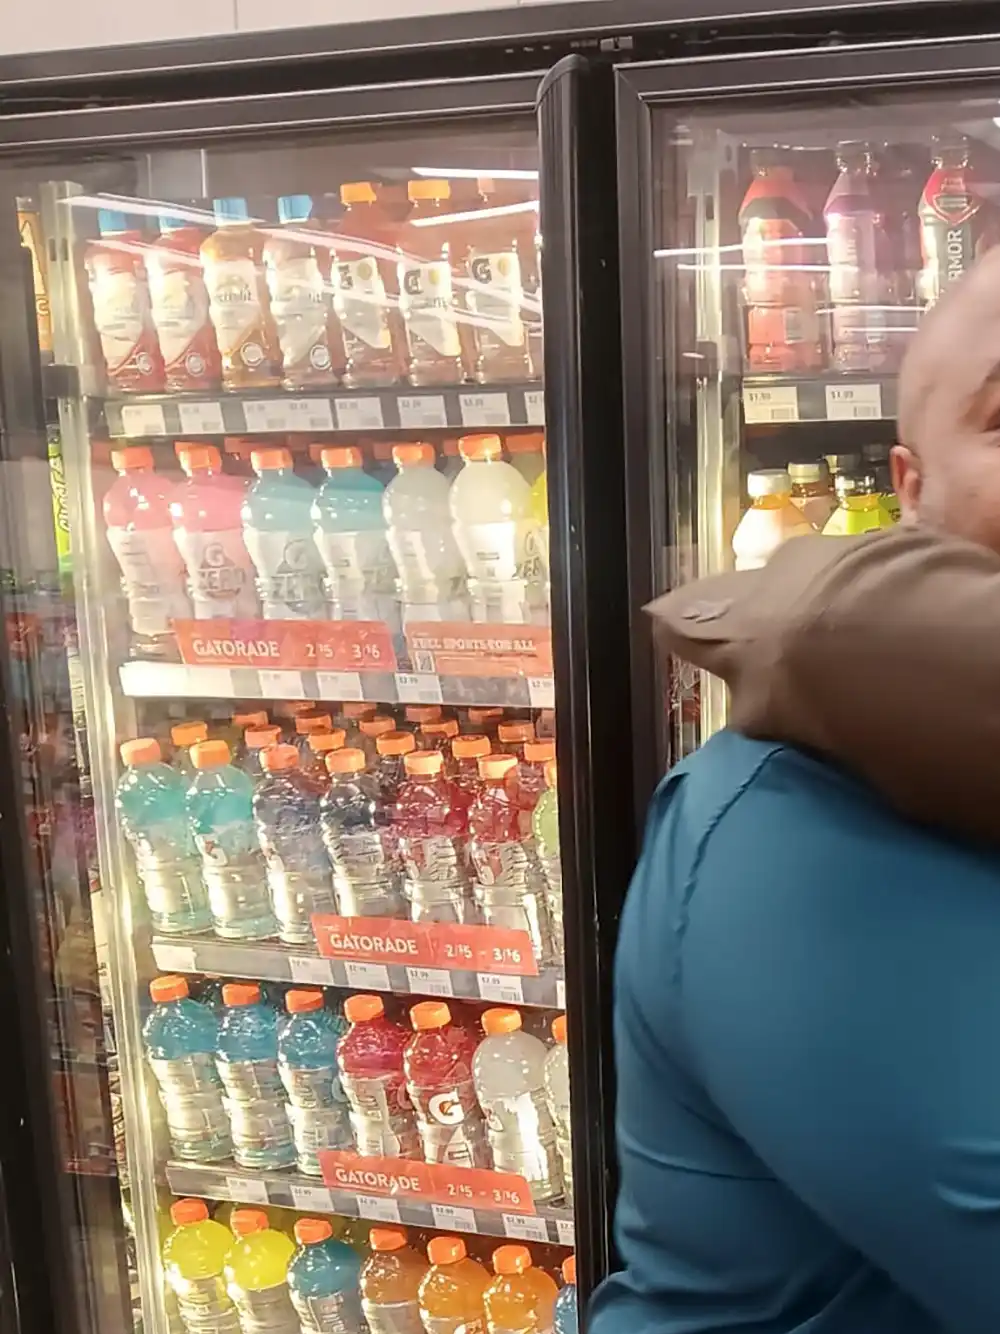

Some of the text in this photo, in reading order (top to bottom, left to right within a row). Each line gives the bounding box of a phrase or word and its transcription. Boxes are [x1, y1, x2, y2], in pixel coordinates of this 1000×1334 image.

[193, 639, 281, 658] GATORADE
[330, 932, 419, 955] GATORADE
[429, 1090, 465, 1125] G
[336, 1167, 422, 1192] GATORADE
